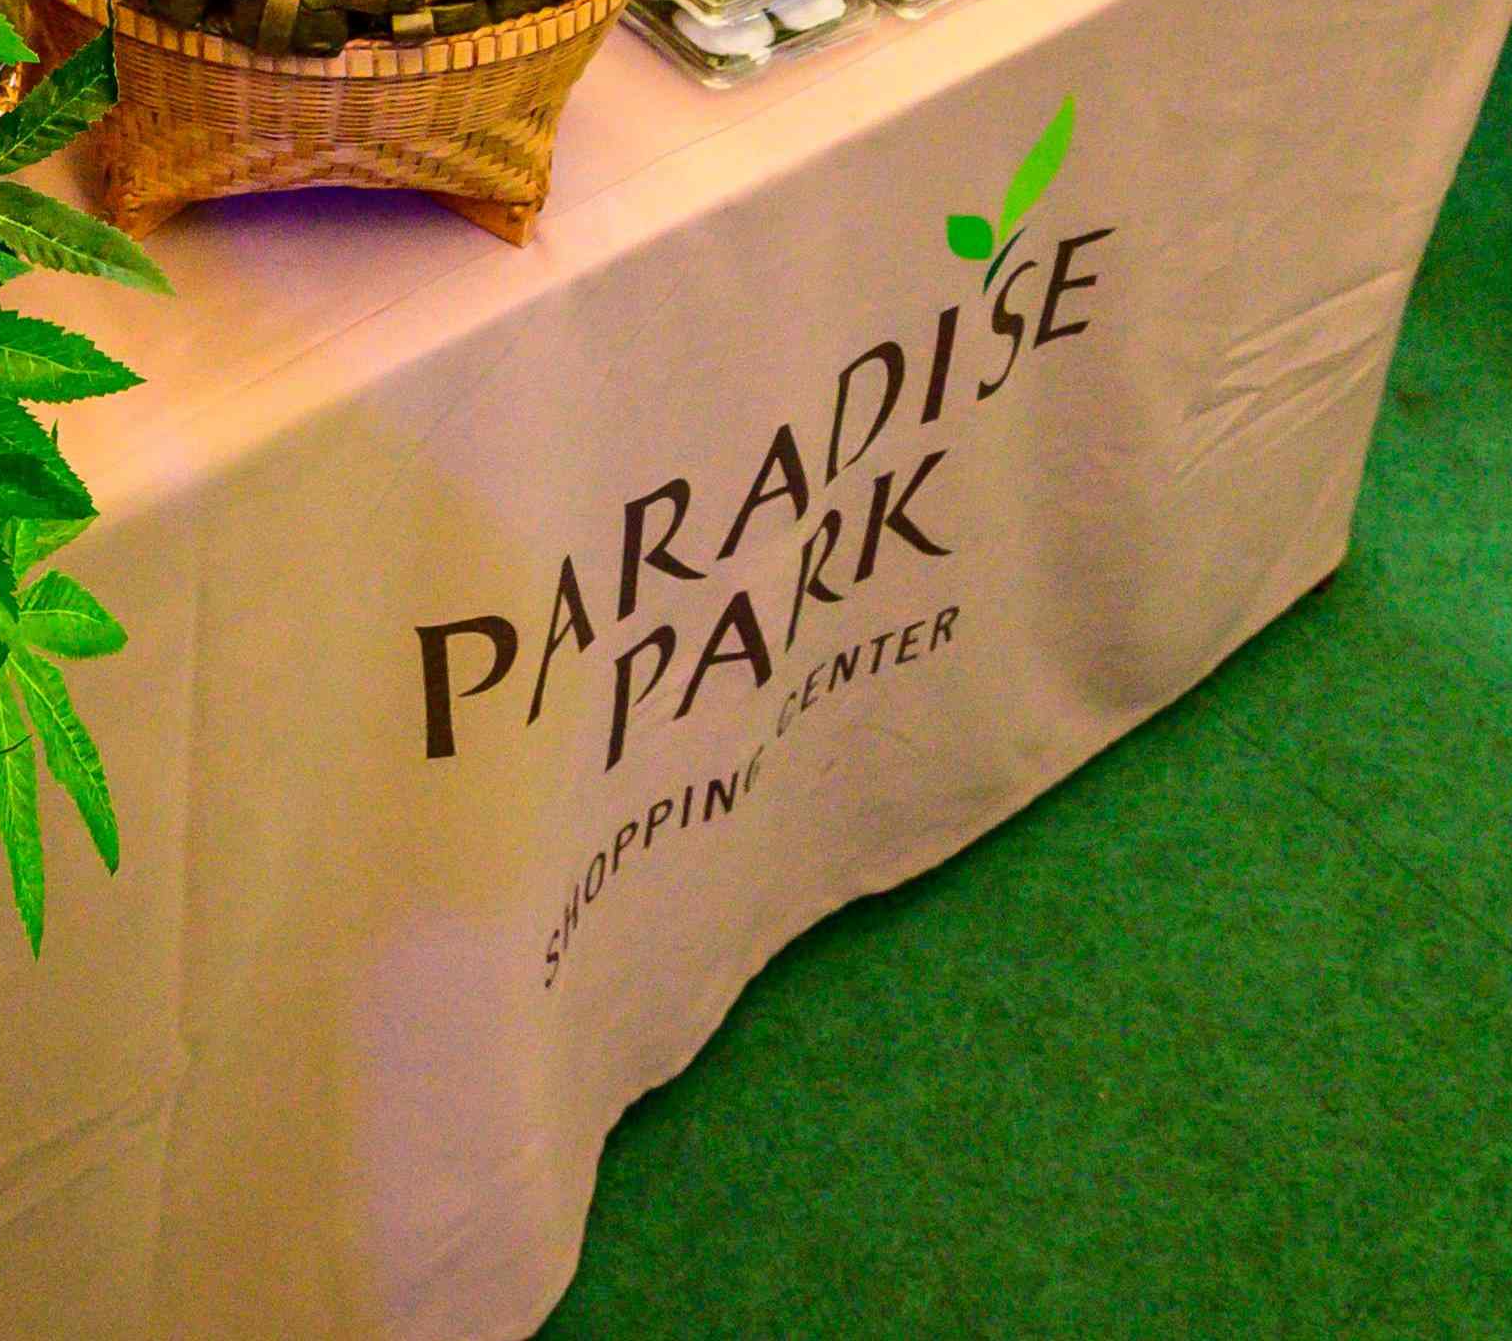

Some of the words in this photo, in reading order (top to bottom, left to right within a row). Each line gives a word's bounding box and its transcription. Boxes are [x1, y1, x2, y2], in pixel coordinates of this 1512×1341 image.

[414, 226, 1114, 759] PARADISE
[604, 450, 952, 774] PARK
[776, 605, 960, 737] CENTER
